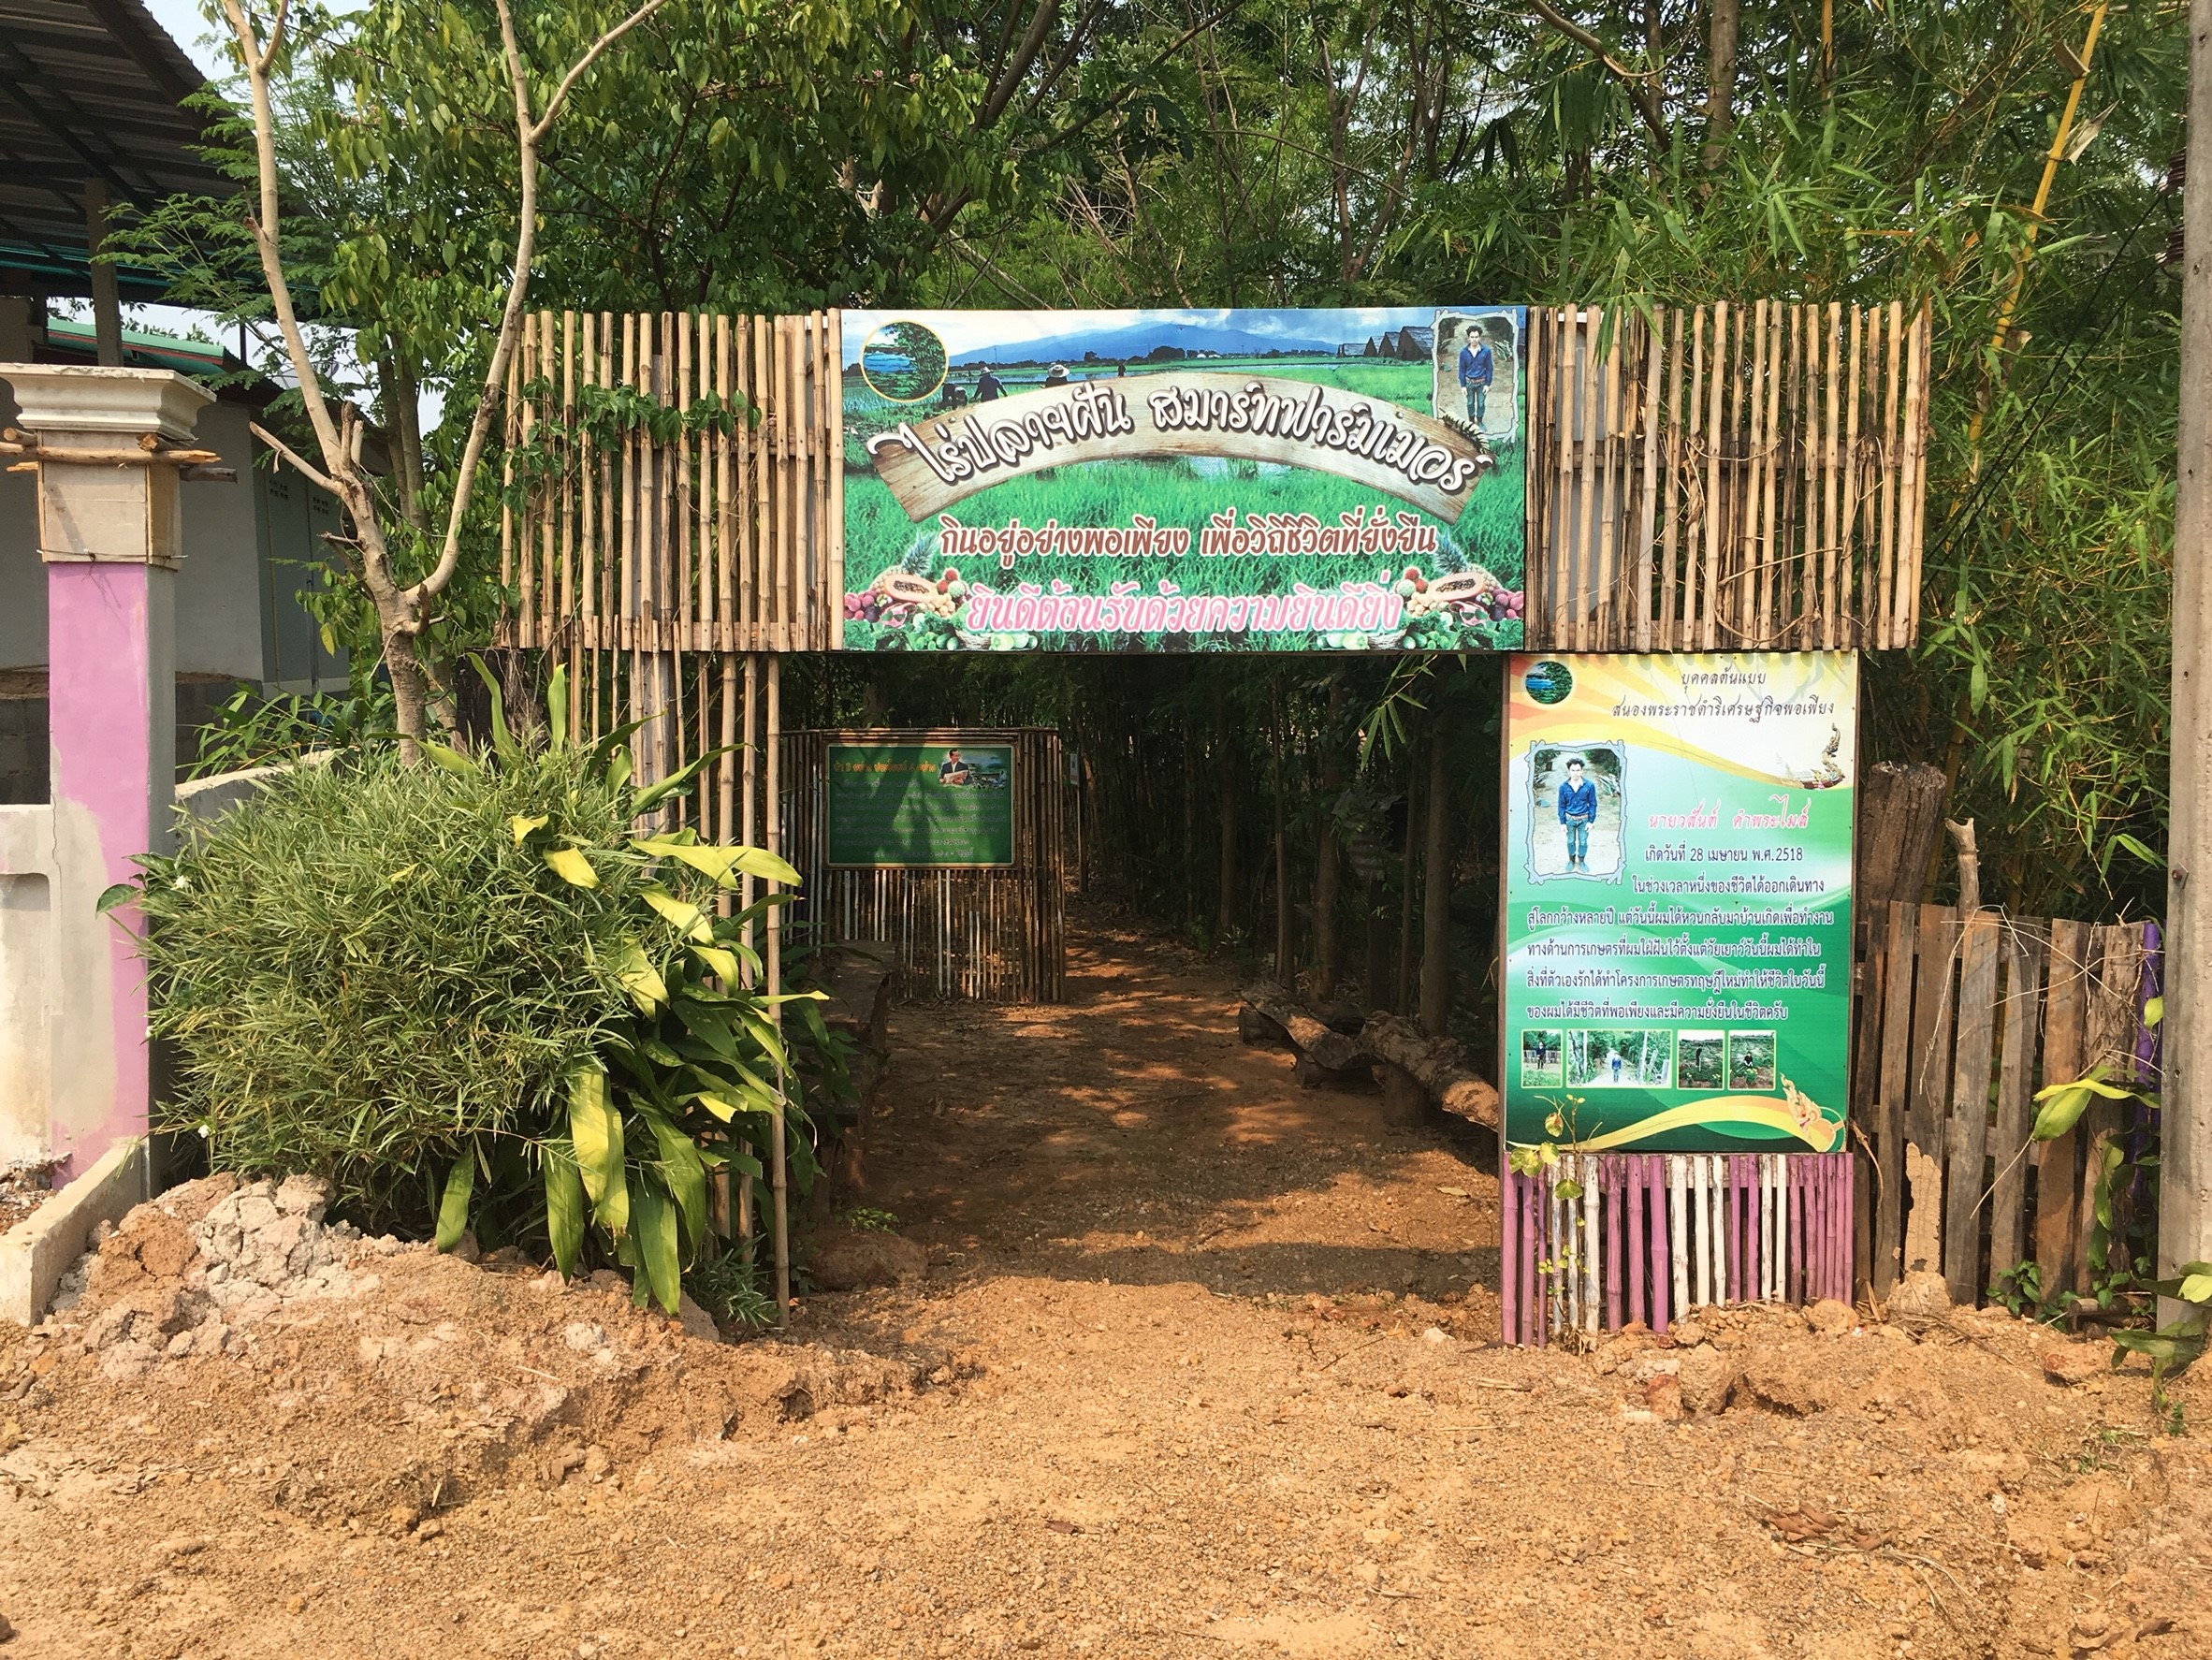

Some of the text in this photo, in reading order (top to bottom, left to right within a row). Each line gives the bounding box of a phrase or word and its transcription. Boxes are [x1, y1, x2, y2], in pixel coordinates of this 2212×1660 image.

[865, 381, 1494, 495] ไร่ปลายฝัน สมาร์ทฟาร์มเมอร์
[939, 507, 1437, 569] กินอยู่อย่างพอเพียง เพื่อวิถีชีวิตที่ยั่งยืน
[966, 571, 1403, 633] ยินดีต้อนรับด้วยความยินดียิ่ง
[1681, 663, 1767, 693] บุคคลต้นแบบ
[1612, 694, 1834, 723] สนองพระราชดำริเศรษฐกิจพอเพียง
[1649, 799, 1720, 830] นายวสันต์
[1646, 840, 1803, 863] เกิดวันที่ 28 เมษายน พ.ศ.2518
[1633, 874, 1825, 895] ในช่วงเวลาหนึ่งของชีวิตได้ออกเดินทาง
[1527, 901, 1834, 931] สู่โลกกว้างหลายปี แต่วันนี้ผมได้หวนกลับมาบ้านเกิดเพื่อทำงาน
[1527, 997, 1788, 1020] ของผมได้มีชีวิตที่พอเพียงและมีความยั่งยืนในชีวิตครับ
